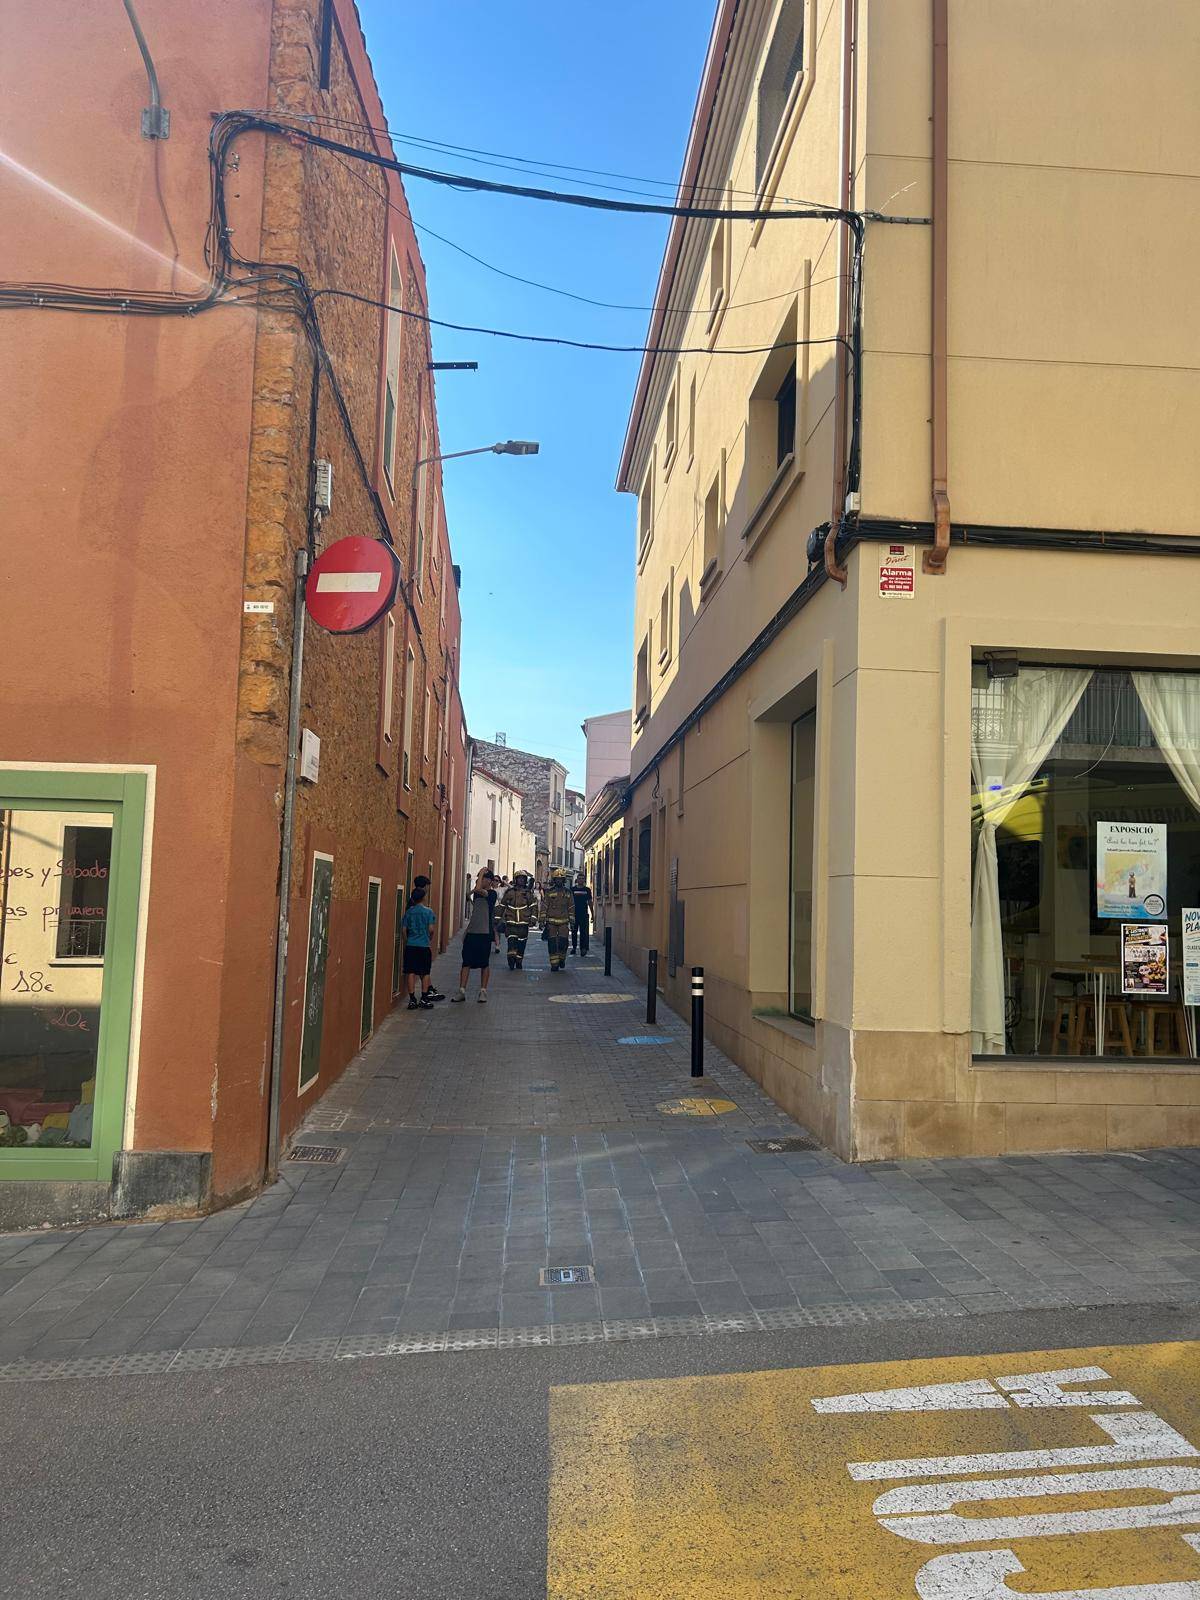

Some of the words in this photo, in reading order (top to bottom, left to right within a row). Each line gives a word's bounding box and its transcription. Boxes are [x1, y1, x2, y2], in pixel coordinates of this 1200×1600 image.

[1110, 825, 1154, 834] EXPOSICIÓ
[42, 867, 51, 887] y
[11, 970, 54, 992] 18€
[50, 1006, 91, 1031] 20€
